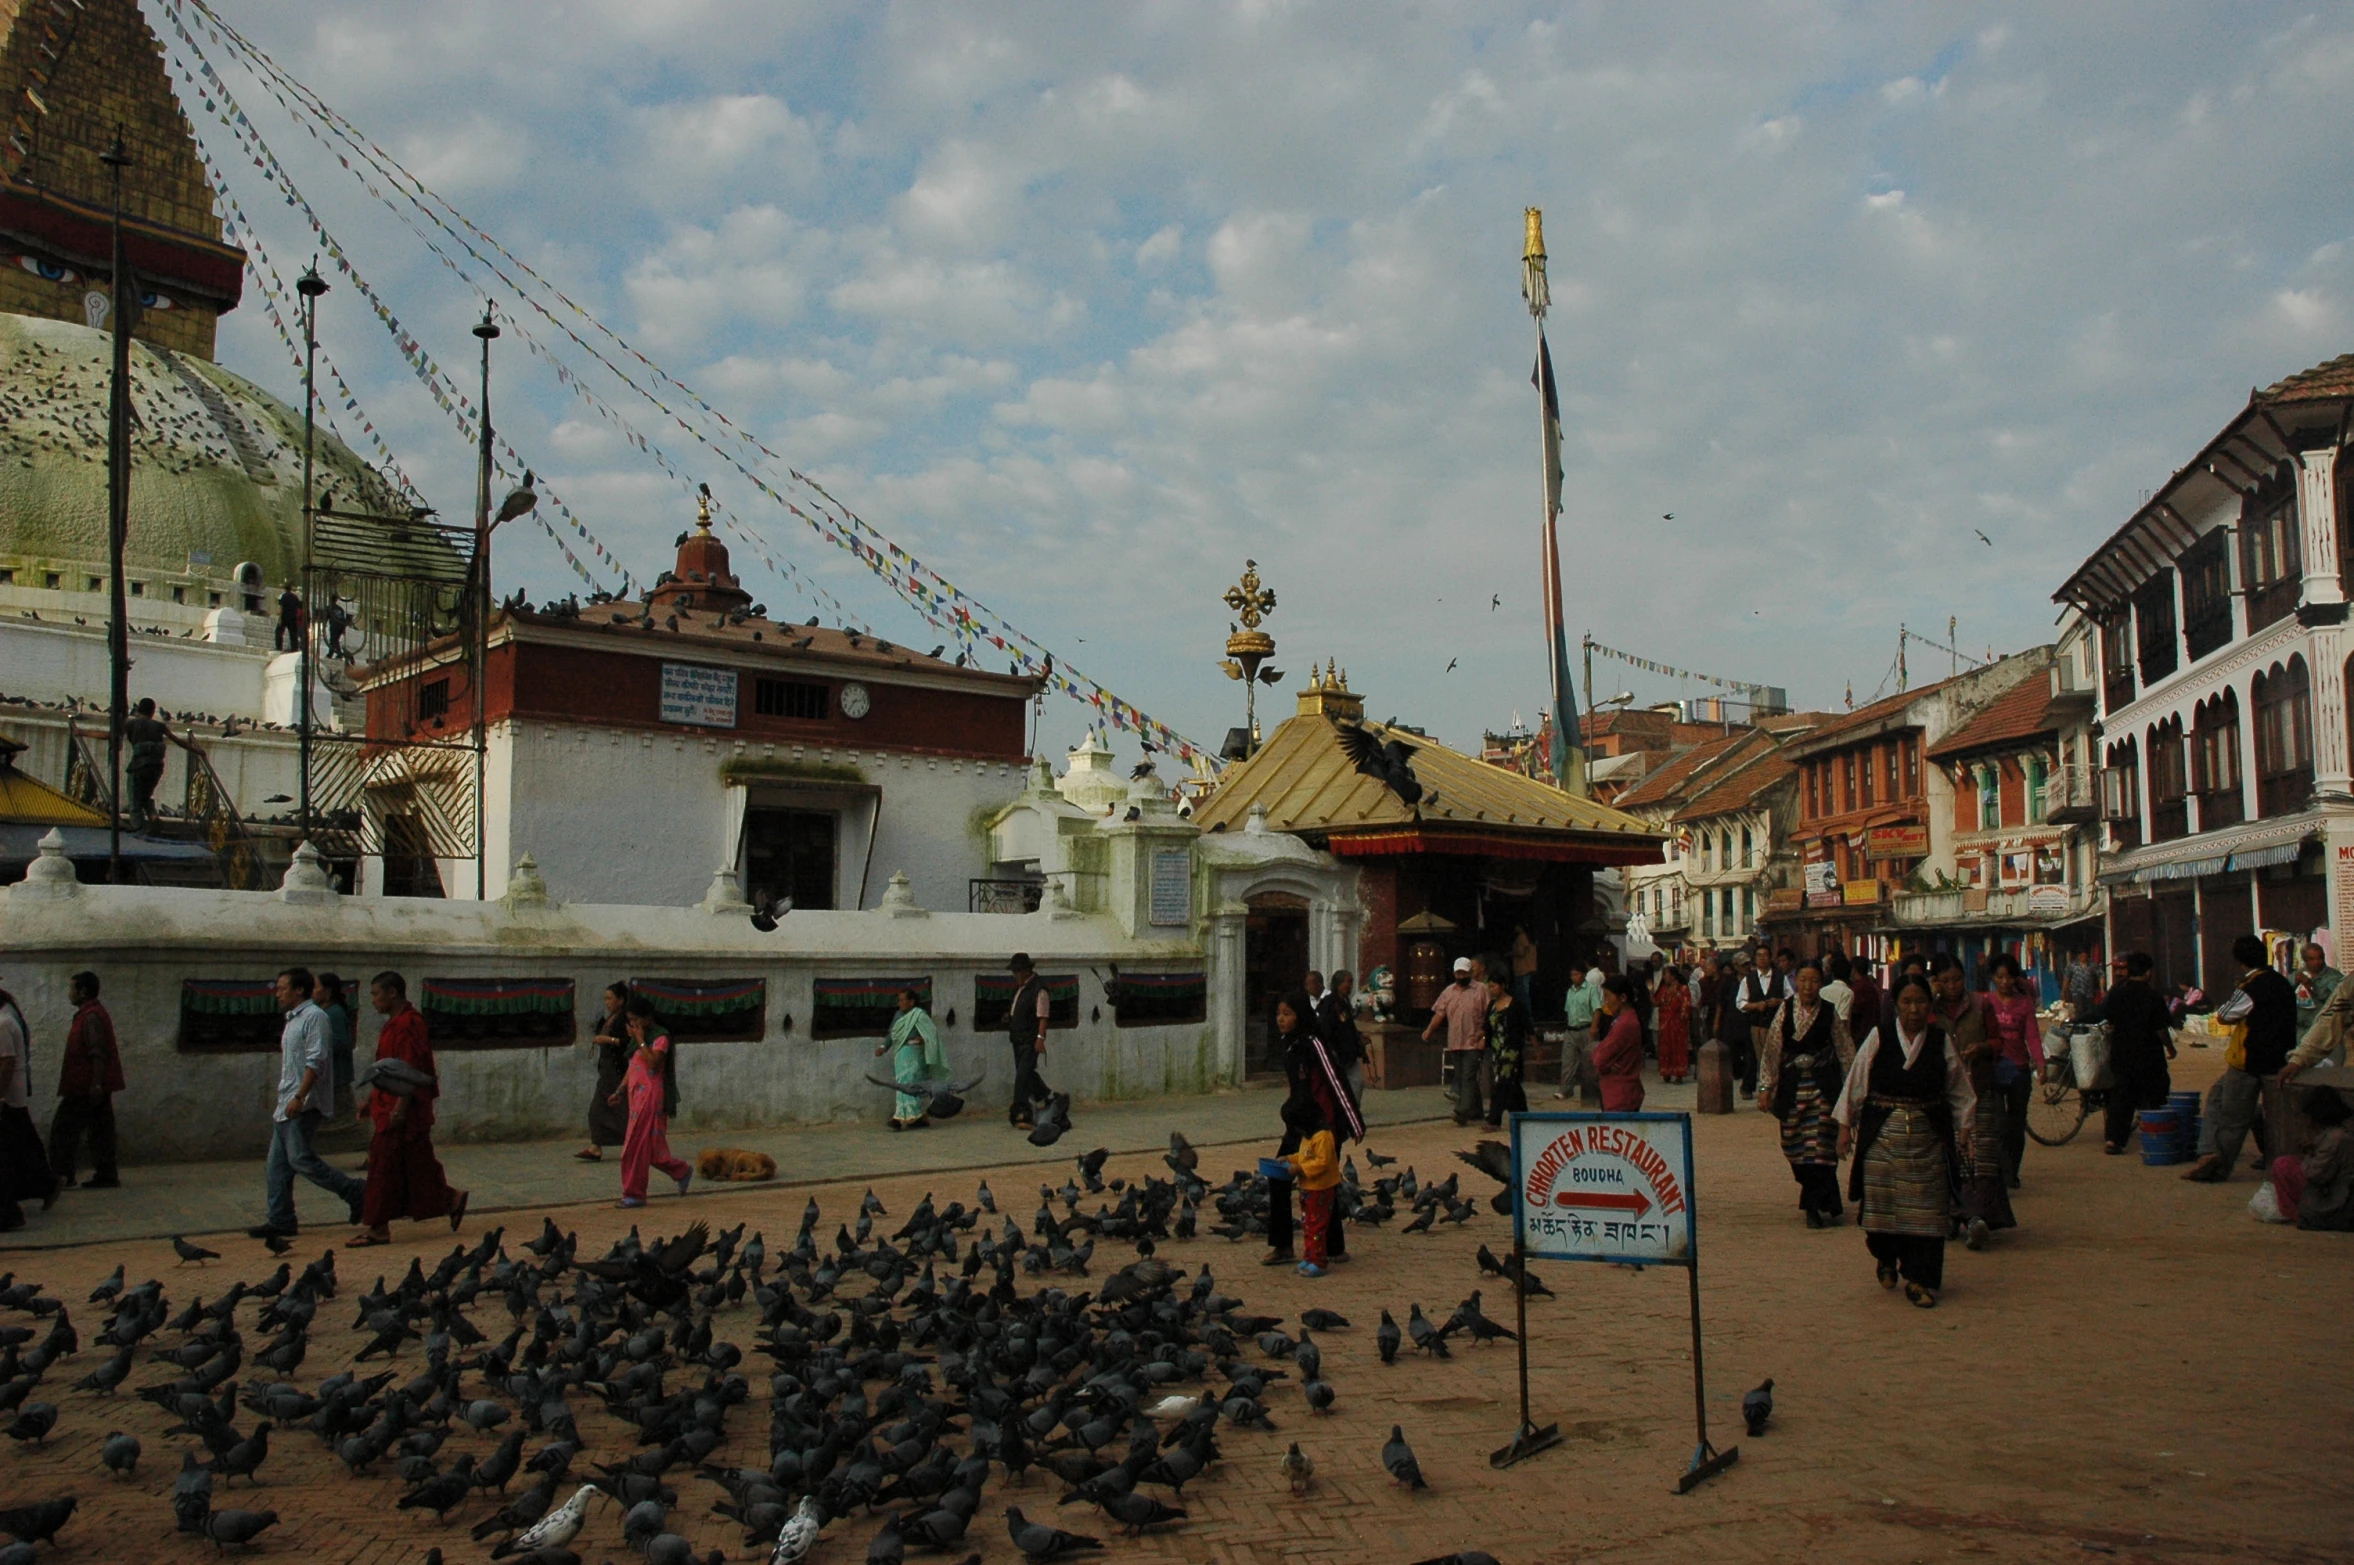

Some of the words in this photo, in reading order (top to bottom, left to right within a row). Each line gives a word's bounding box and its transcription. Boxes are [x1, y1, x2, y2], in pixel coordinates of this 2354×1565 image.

[1871, 828, 1907, 839] SKY
[1902, 833, 1925, 841] NET
[1525, 1129, 1584, 1208] CHHORTEN
[1587, 1125, 1686, 1217] RESTAURANT
[1572, 1167, 1625, 1185] BOUDHA
